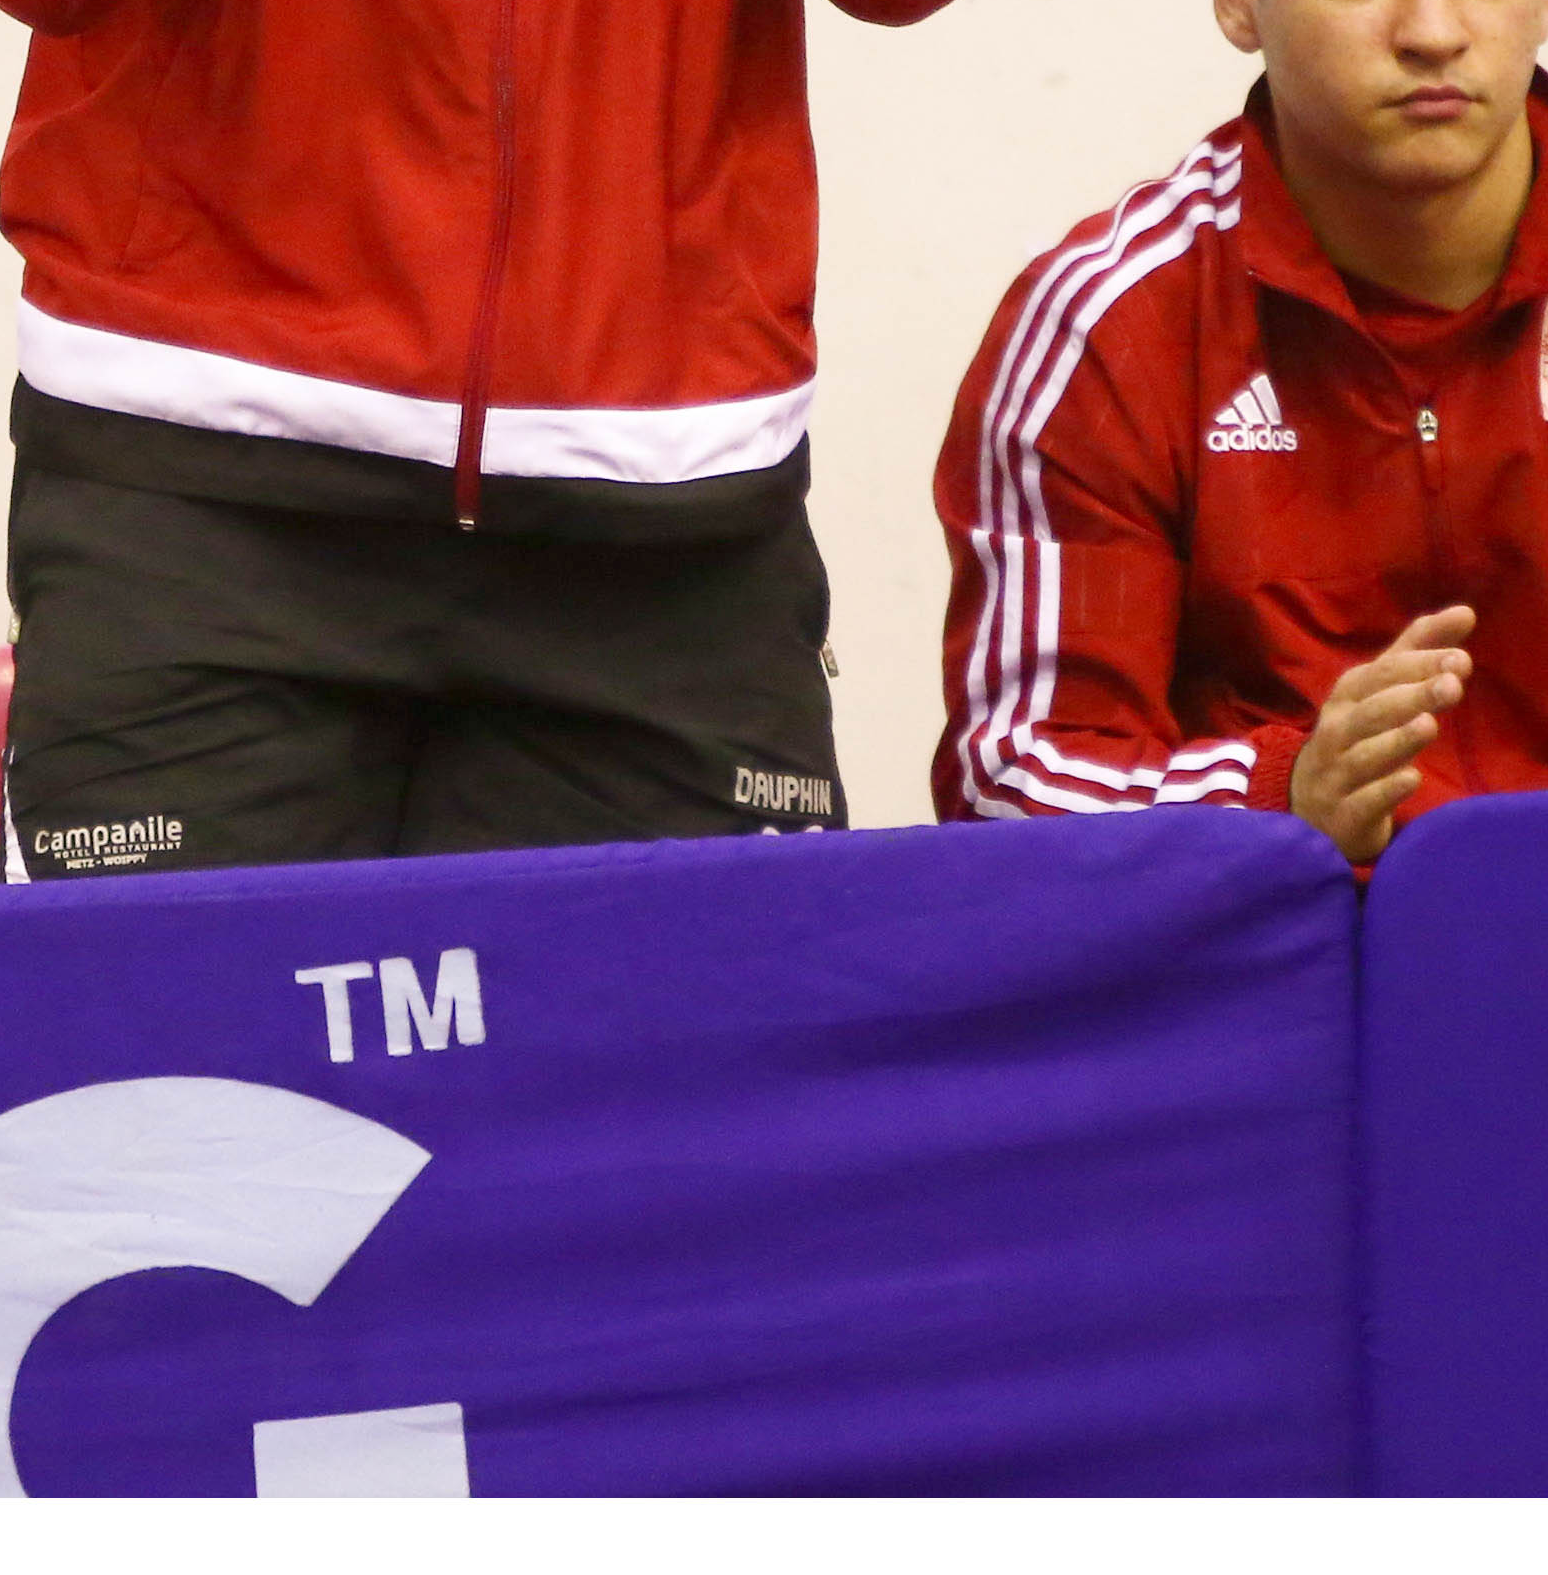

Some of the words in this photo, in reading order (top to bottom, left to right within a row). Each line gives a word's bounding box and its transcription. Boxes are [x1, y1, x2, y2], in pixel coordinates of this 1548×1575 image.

[1208, 423, 1298, 452] adidas
[734, 766, 832, 815] DAUPHIN
[35, 815, 183, 855] Campanile
[54, 849, 91, 859] HOTEL
[104, 842, 181, 854] RESTAURANT
[295, 947, 486, 1063] TM
